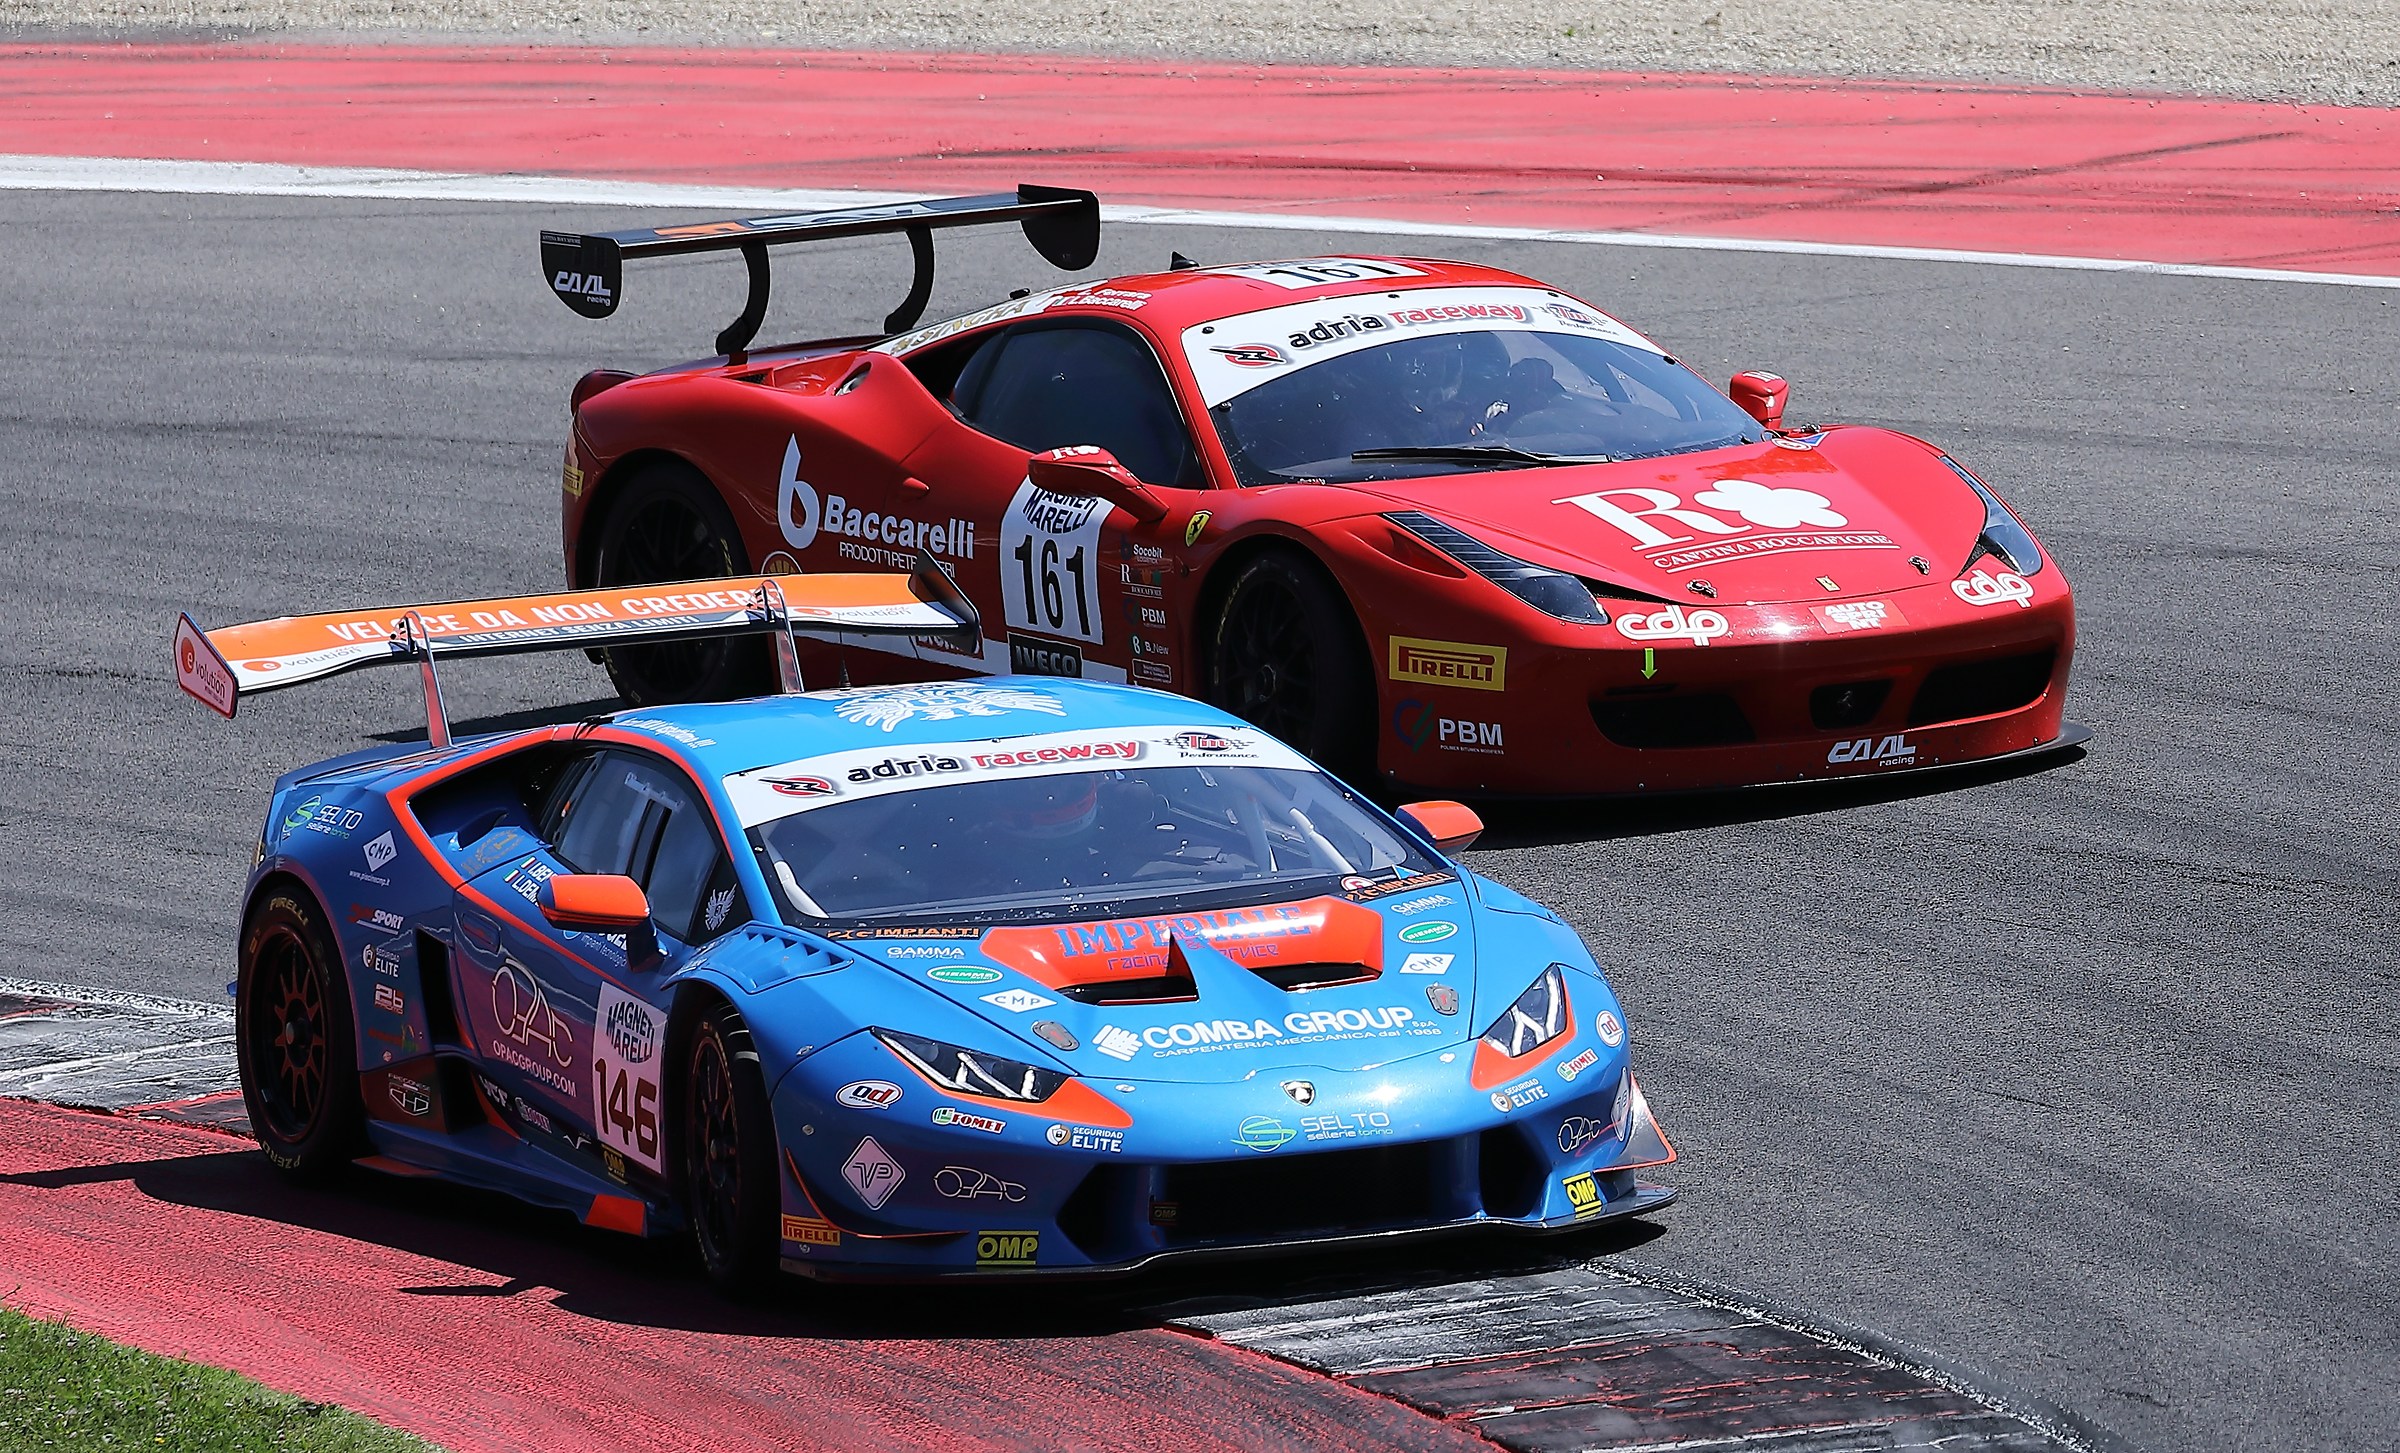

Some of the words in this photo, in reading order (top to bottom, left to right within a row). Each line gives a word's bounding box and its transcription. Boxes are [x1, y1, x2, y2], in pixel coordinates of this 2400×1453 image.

[1288, 314, 1384, 349] adria
[1388, 303, 1525, 325] raceway
[824, 494, 975, 560] Baccarelli
[1022, 500, 1095, 534] MARELLI
[840, 541, 891, 567] PRODOTTI
[1133, 544, 1162, 559] Socobit
[1653, 543, 1753, 568] CANTINA
[1751, 533, 1894, 552] ROCCAFIORE
[1015, 535, 1091, 636] 161
[470, 609, 528, 627] DA
[531, 601, 614, 624] NON
[1141, 607, 1166, 625] PBM
[1825, 601, 1885, 615] AUTO
[459, 627, 560, 643] INTERNET
[562, 621, 630, 635] SENZA
[633, 615, 699, 628] LIMITI
[1615, 604, 1730, 647] cdp
[1016, 645, 1077, 675] IVECO
[1398, 645, 1496, 682] PIRELLI
[1439, 718, 1503, 746] PBM
[847, 755, 960, 783] adria
[971, 740, 1137, 767] raceway
[1879, 756, 1915, 767] racing
[314, 805, 364, 830] SELTO
[368, 843, 392, 860] CMP
[1391, 894, 1452, 913] GAMMA
[372, 909, 404, 930] SPORT
[887, 946, 965, 956] GAMMA
[1107, 952, 1173, 971] racing
[375, 958, 399, 978] ELITE
[1409, 956, 1444, 972] CMP
[994, 995, 1041, 1006] CMP
[607, 1001, 655, 1039] MAGNETI
[1142, 1019, 1283, 1050] COMBA
[1283, 1006, 1414, 1035] GROUP
[606, 1018, 653, 1064] MARELLI
[1152, 1040, 1274, 1058] CARPENTERIA
[1276, 1030, 1377, 1047] MECCANICA
[492, 1040, 577, 1098] OPACGROUP.COM
[1569, 1050, 1597, 1073] FOMET
[1504, 1077, 1539, 1096] SEGURIDAD
[1513, 1084, 1549, 1108] ELITE
[595, 1057, 658, 1160] 146
[952, 1114, 1003, 1132] FOMET
[1072, 1126, 1123, 1140] SEGURIDAD
[1301, 1111, 1391, 1132] SELTO
[1071, 1136, 1122, 1152] ELITE
[1307, 1129, 1357, 1141] sellerie
[1358, 1128, 1394, 1137] torino
[1567, 1178, 1596, 1205] OMP
[782, 1217, 838, 1243] PIRELLI
[978, 1237, 1038, 1258] OMP
